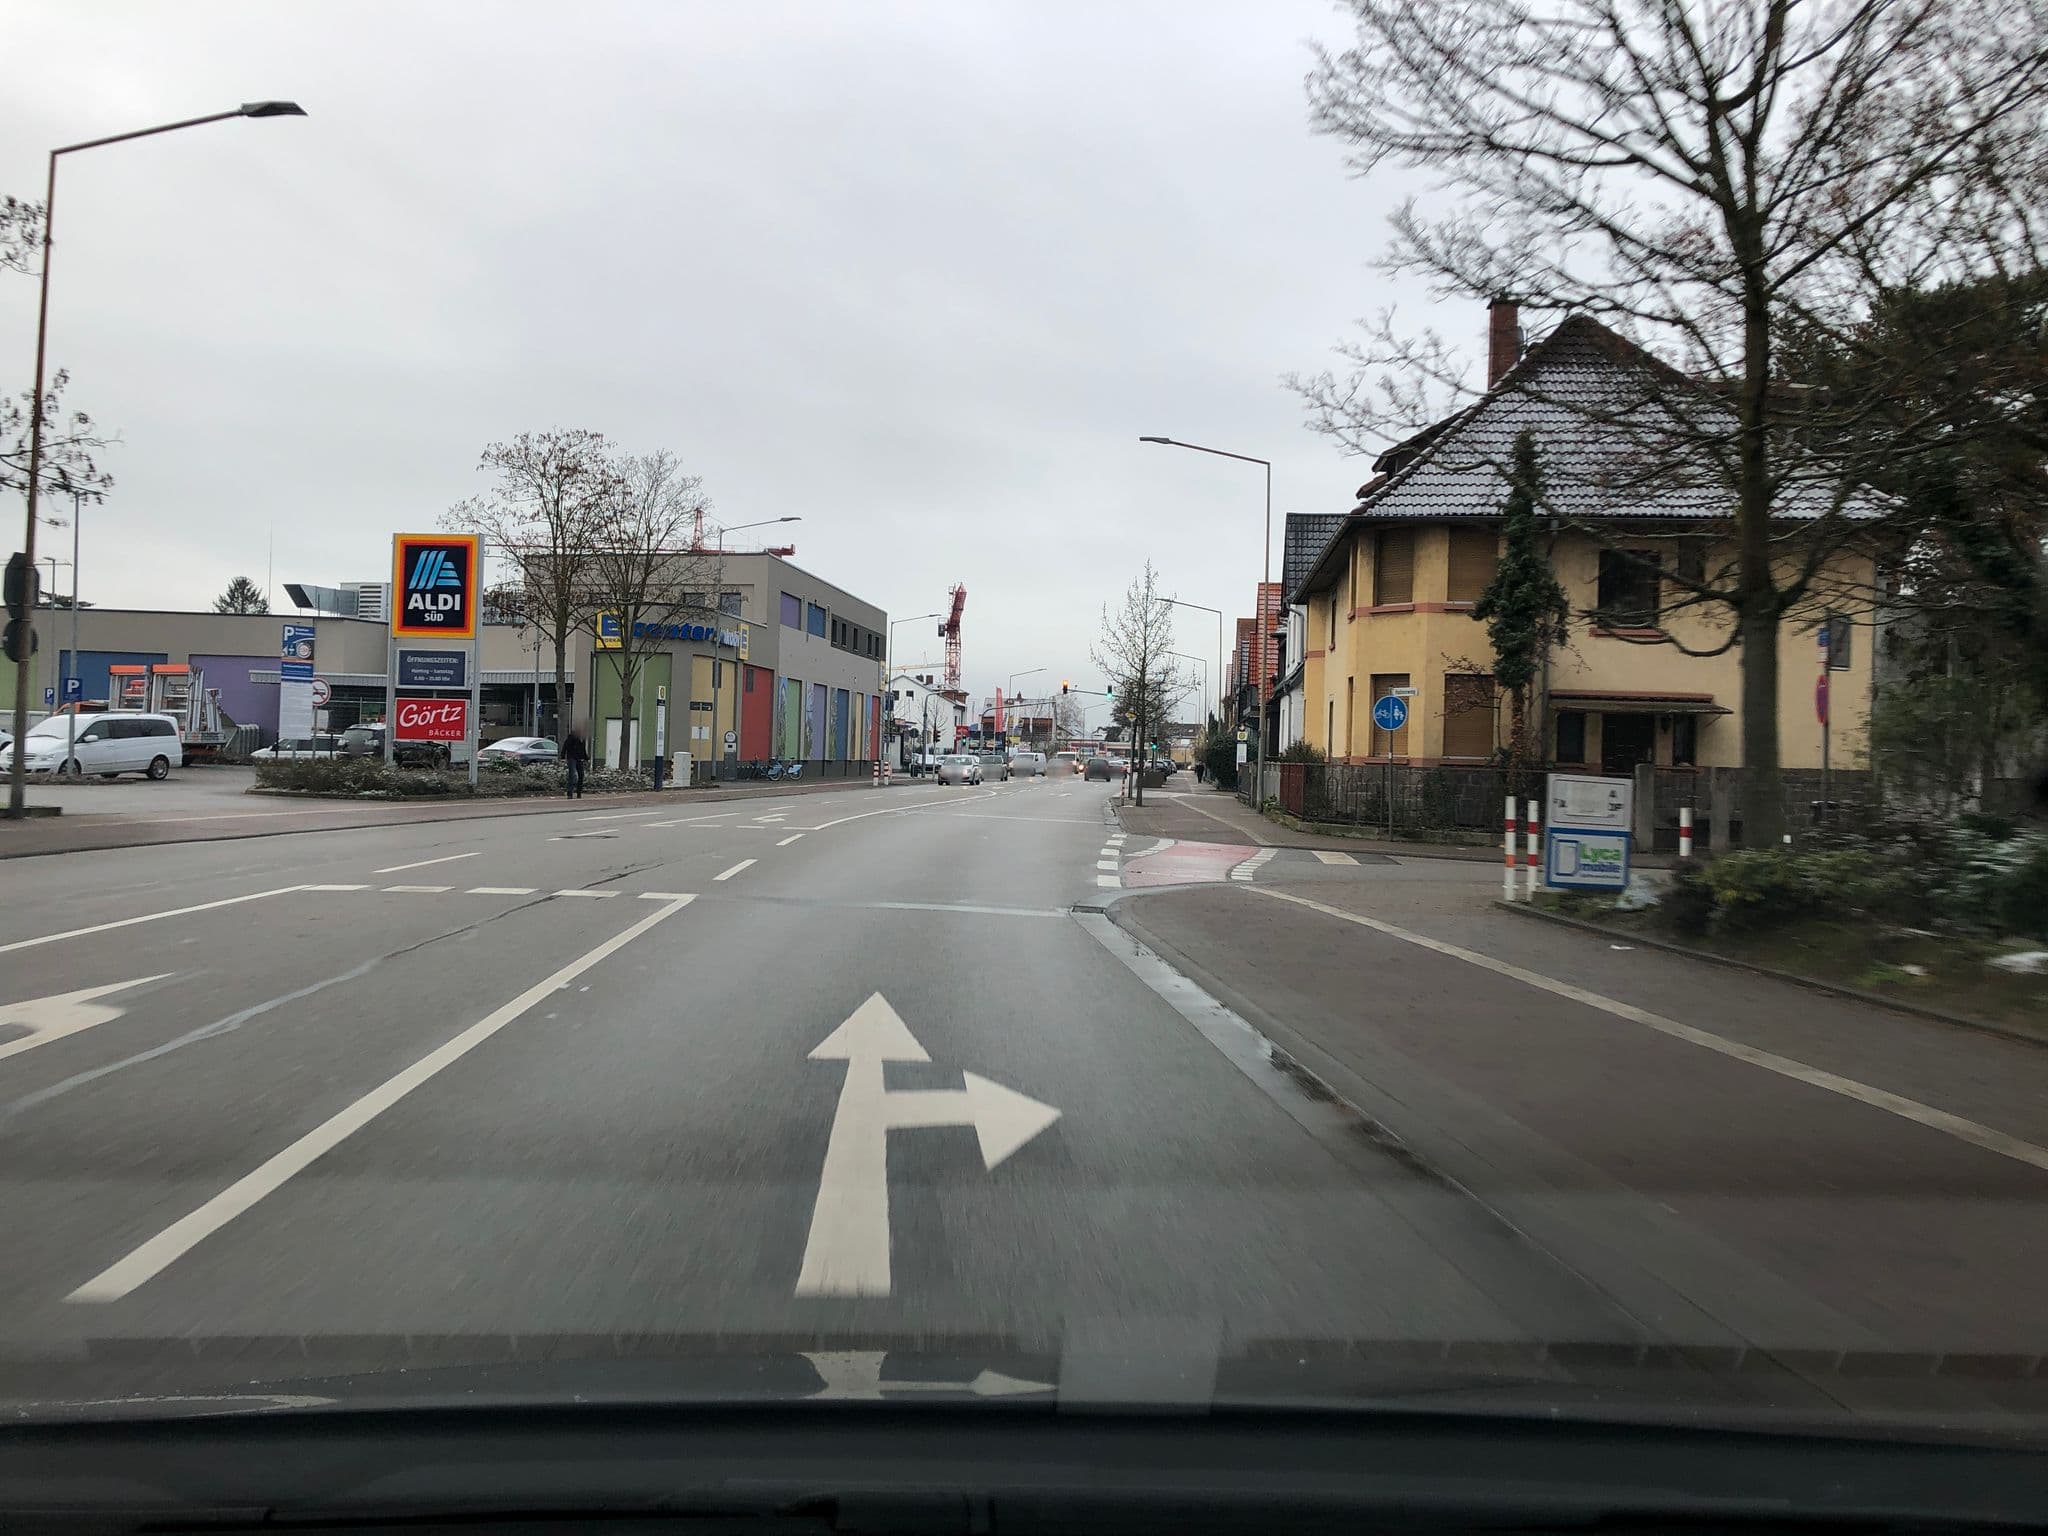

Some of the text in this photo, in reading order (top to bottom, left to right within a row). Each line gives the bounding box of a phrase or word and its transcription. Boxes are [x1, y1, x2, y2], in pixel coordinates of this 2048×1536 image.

[408, 593, 461, 611] ALDI
[424, 611, 444, 622] SÜD
[284, 626, 295, 641] P
[67, 679, 80, 693] P
[46, 688, 54, 699] P
[399, 703, 463, 728] Görtz
[428, 728, 462, 737] BÄCKER
[1580, 843, 1622, 862] Lyca
